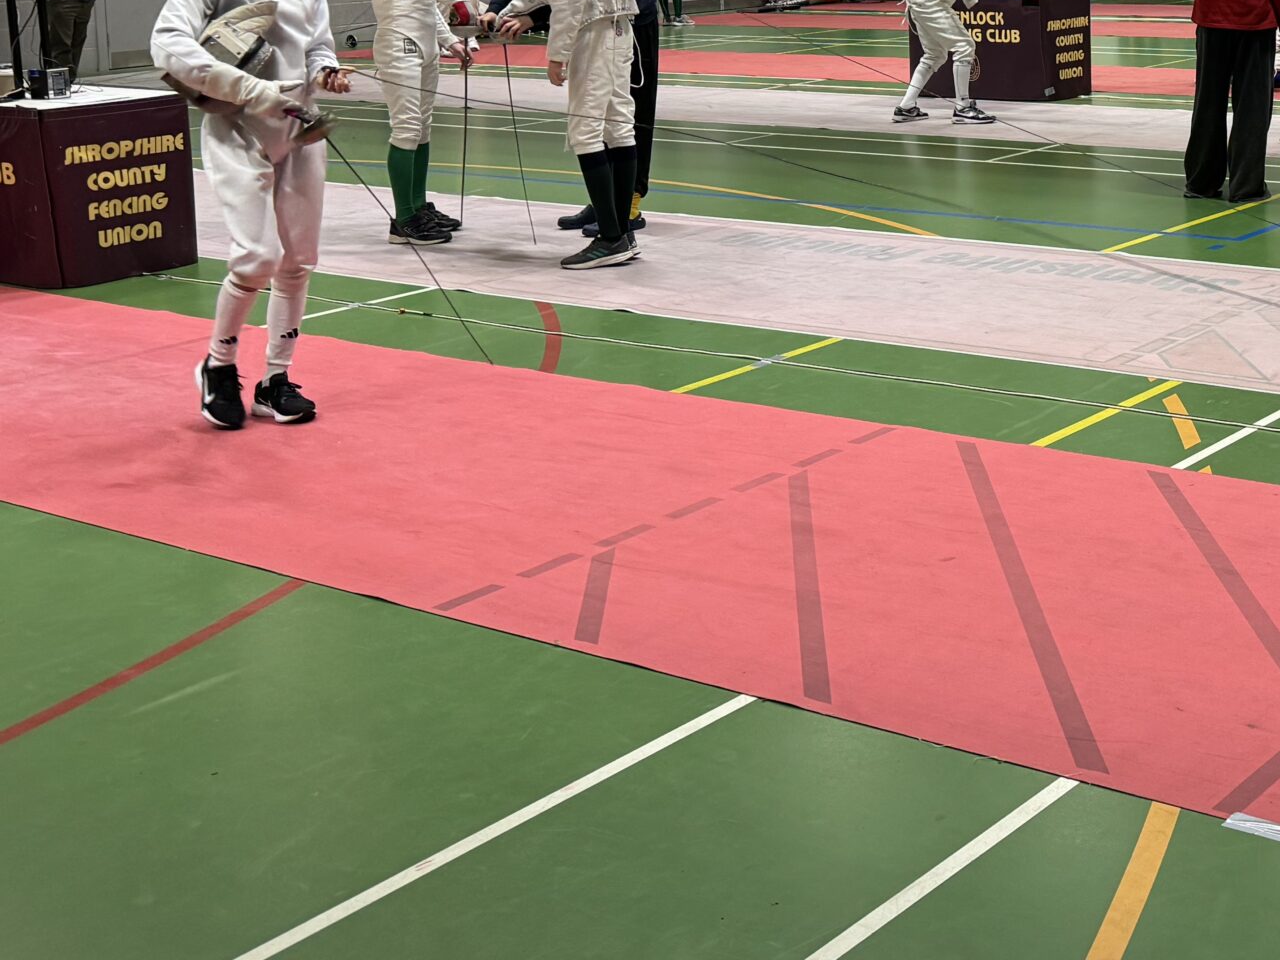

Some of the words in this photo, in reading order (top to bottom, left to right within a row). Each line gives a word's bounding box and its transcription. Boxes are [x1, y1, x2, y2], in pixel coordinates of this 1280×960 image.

[1046, 15, 1089, 32] SHROPSHIRE
[986, 29, 1021, 43] CLUB
[1055, 32, 1084, 47] COUNTY
[1055, 49, 1085, 64] FENCING
[1059, 66, 1083, 80] UNION
[64, 132, 184, 166] SHROPSHIRE
[86, 163, 166, 191] COUNTY
[88, 191, 169, 221] FENCING
[98, 220, 163, 248] UNION
